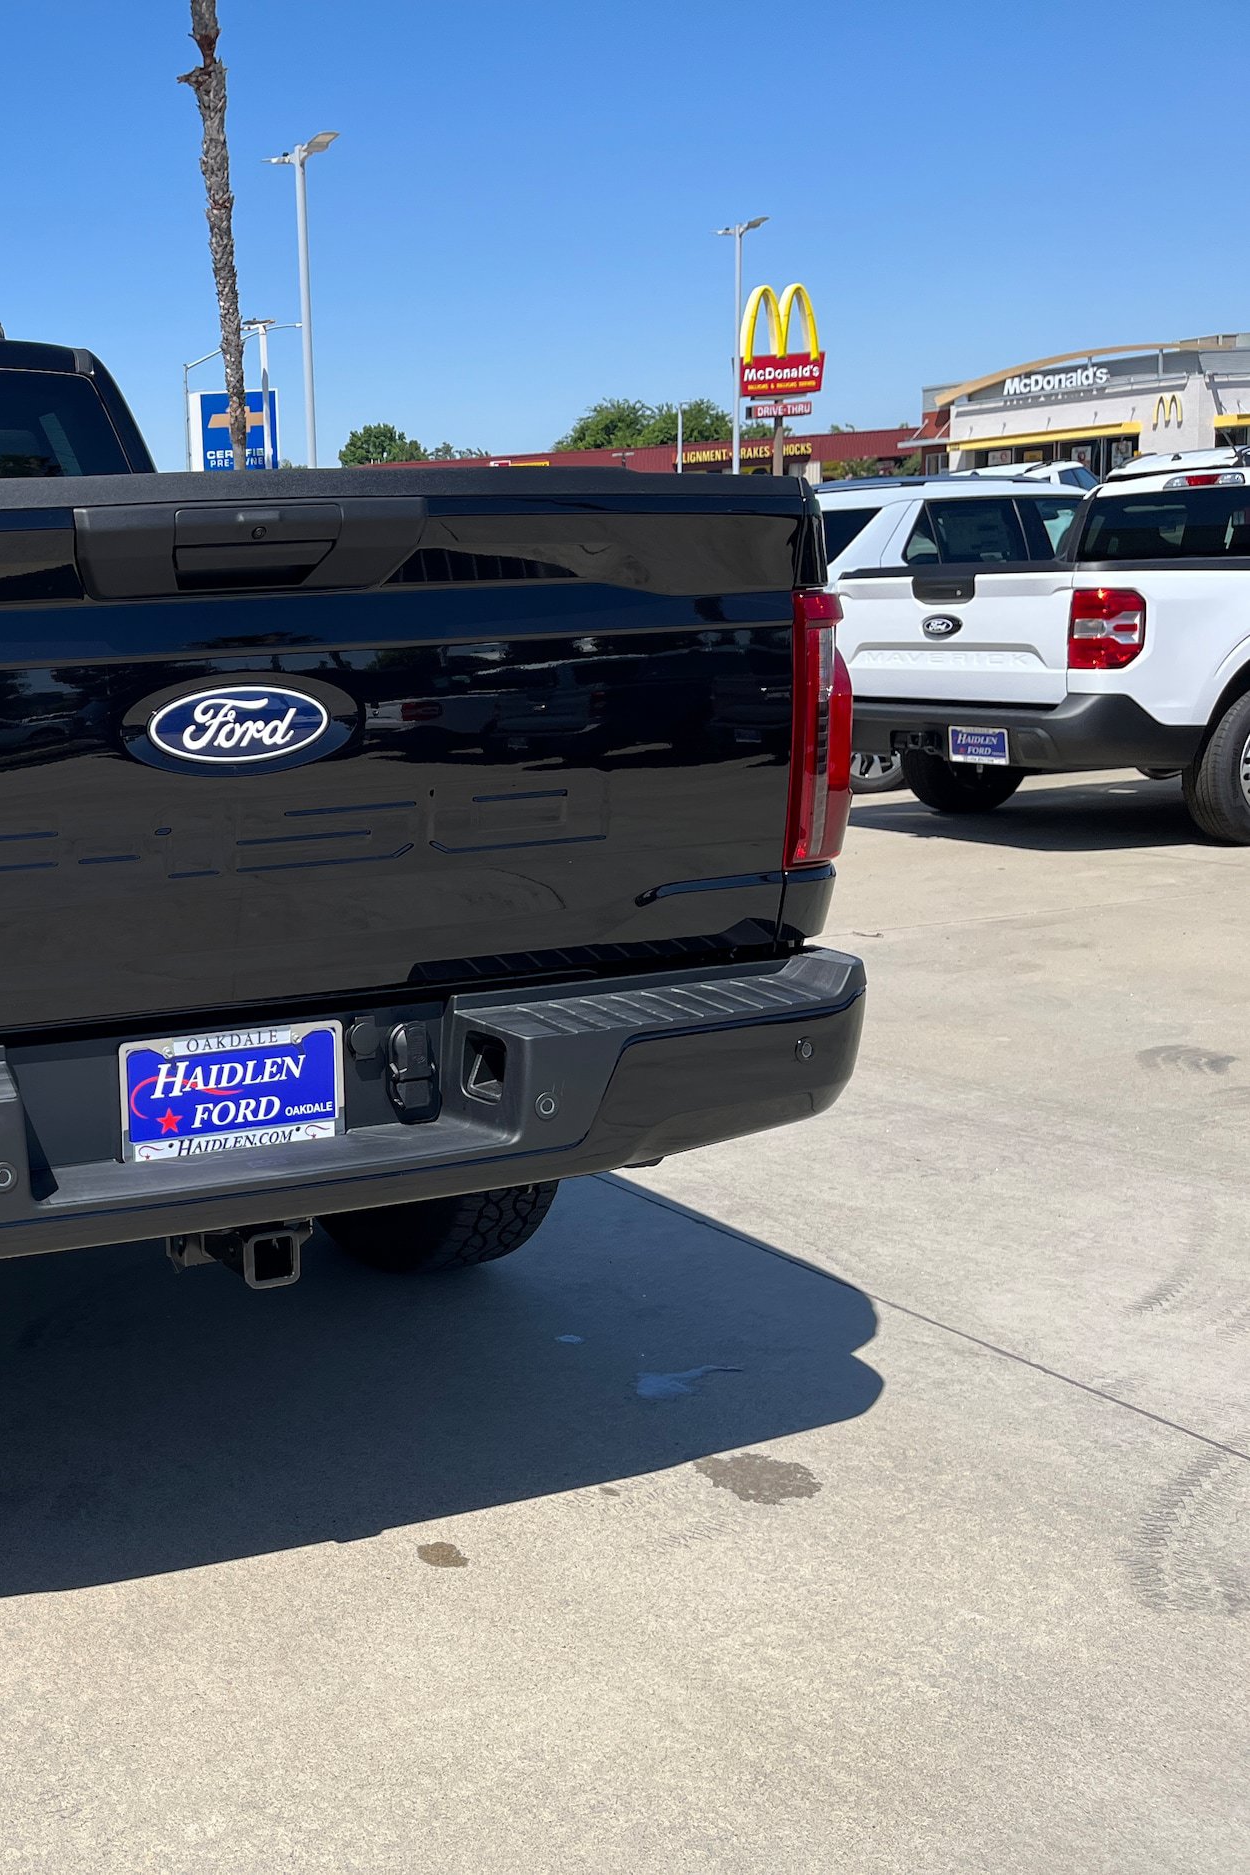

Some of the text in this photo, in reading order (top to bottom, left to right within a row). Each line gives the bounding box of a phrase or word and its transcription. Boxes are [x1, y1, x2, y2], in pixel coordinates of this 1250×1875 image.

[743, 365, 820, 382] McDonald's
[1003, 367, 1109, 396] McDonald's
[739, 445, 770, 460] RAKES
[782, 442, 813, 456] HOCKS
[182, 697, 297, 750] Ford
[957, 733, 998, 745] HAIDLEN
[967, 745, 992, 755] FORD
[187, 1029, 278, 1052] OAKDALE
[150, 1055, 306, 1099] HAIDLEN
[191, 1095, 333, 1129] FORD OAKDALE
[177, 1129, 295, 1157] HAIDLEN.COM
